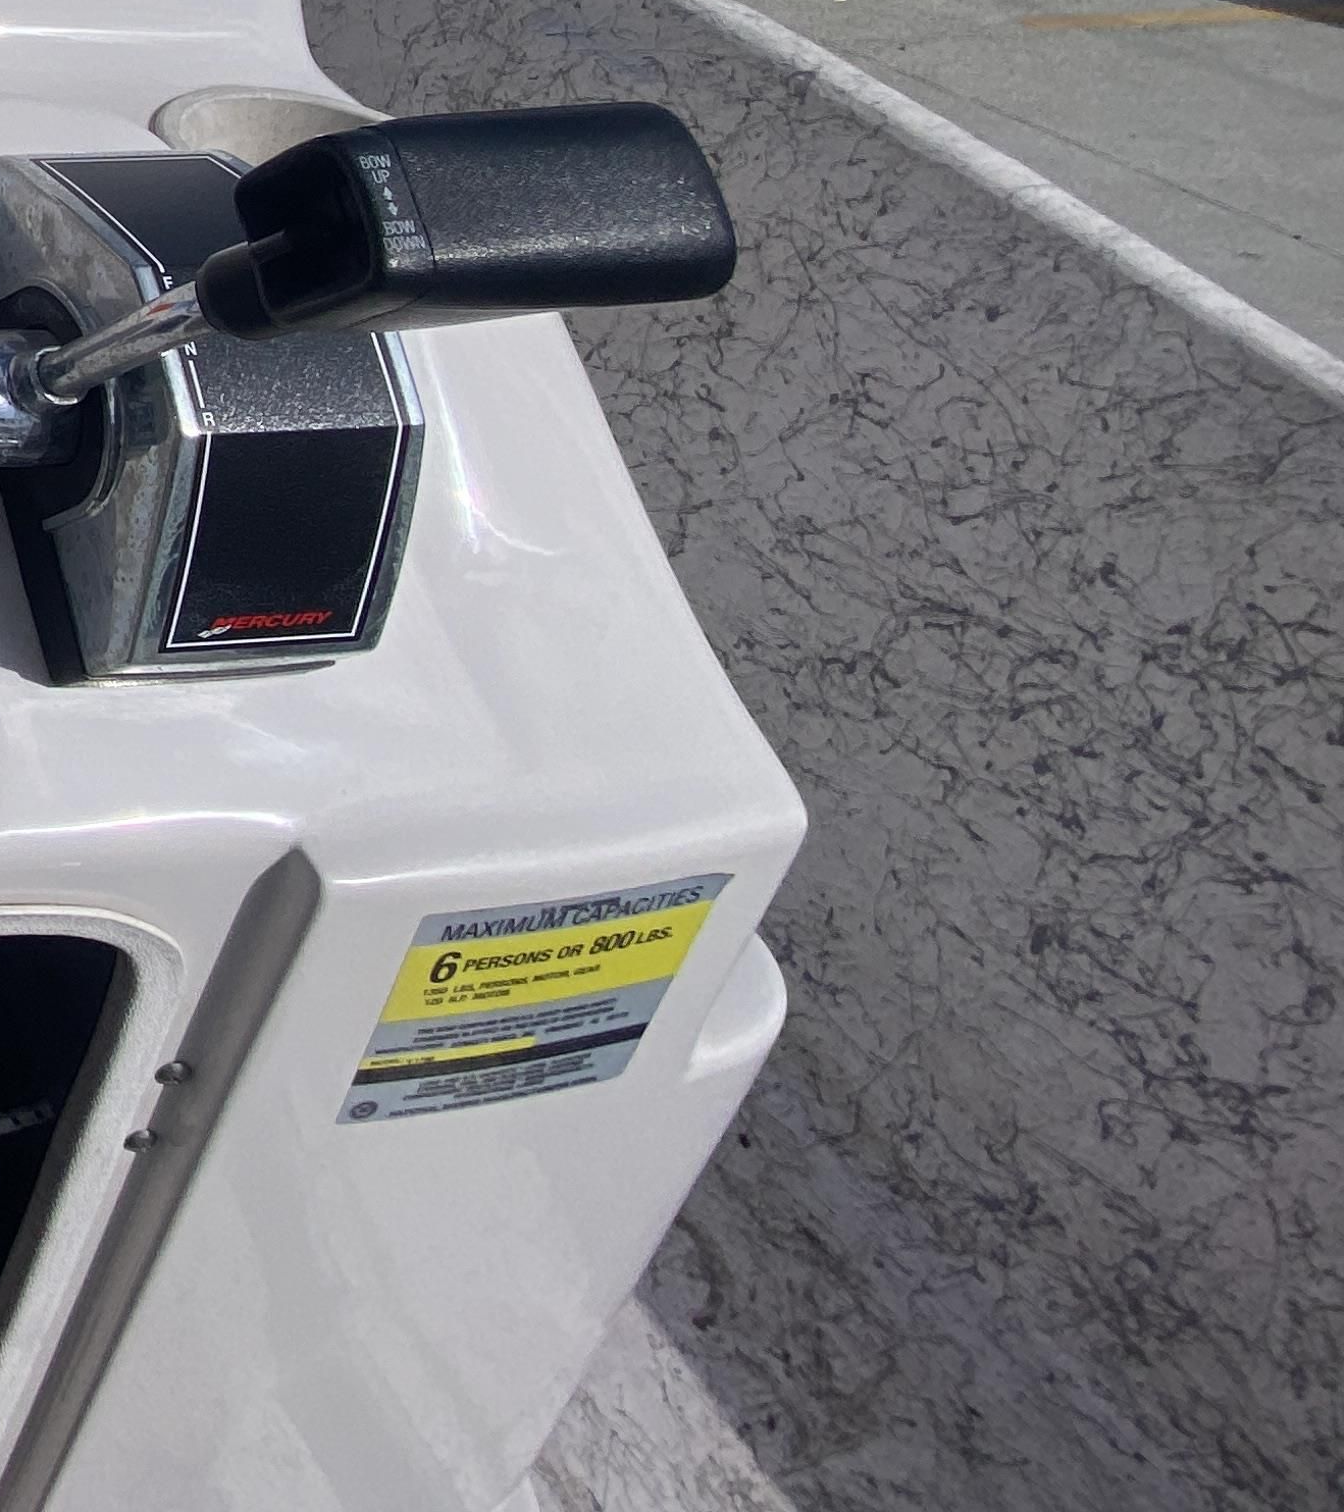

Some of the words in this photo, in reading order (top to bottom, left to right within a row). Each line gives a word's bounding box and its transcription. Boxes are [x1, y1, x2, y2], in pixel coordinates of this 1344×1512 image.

[359, 154, 391, 170] BOW
[372, 170, 391, 185] UP
[384, 220, 417, 236] BOW
[384, 235, 427, 251] DOWN
[162, 275, 173, 290] F
[184, 341, 198, 356] N
[201, 411, 216, 427] R
[211, 609, 333, 630] MERCURY
[440, 907, 567, 943] MAXIMUM
[572, 885, 705, 925] CAPACITIES
[429, 951, 464, 985] 6
[462, 948, 553, 974] PERSONS
[558, 943, 585, 960] OR
[588, 928, 635, 956] 800
